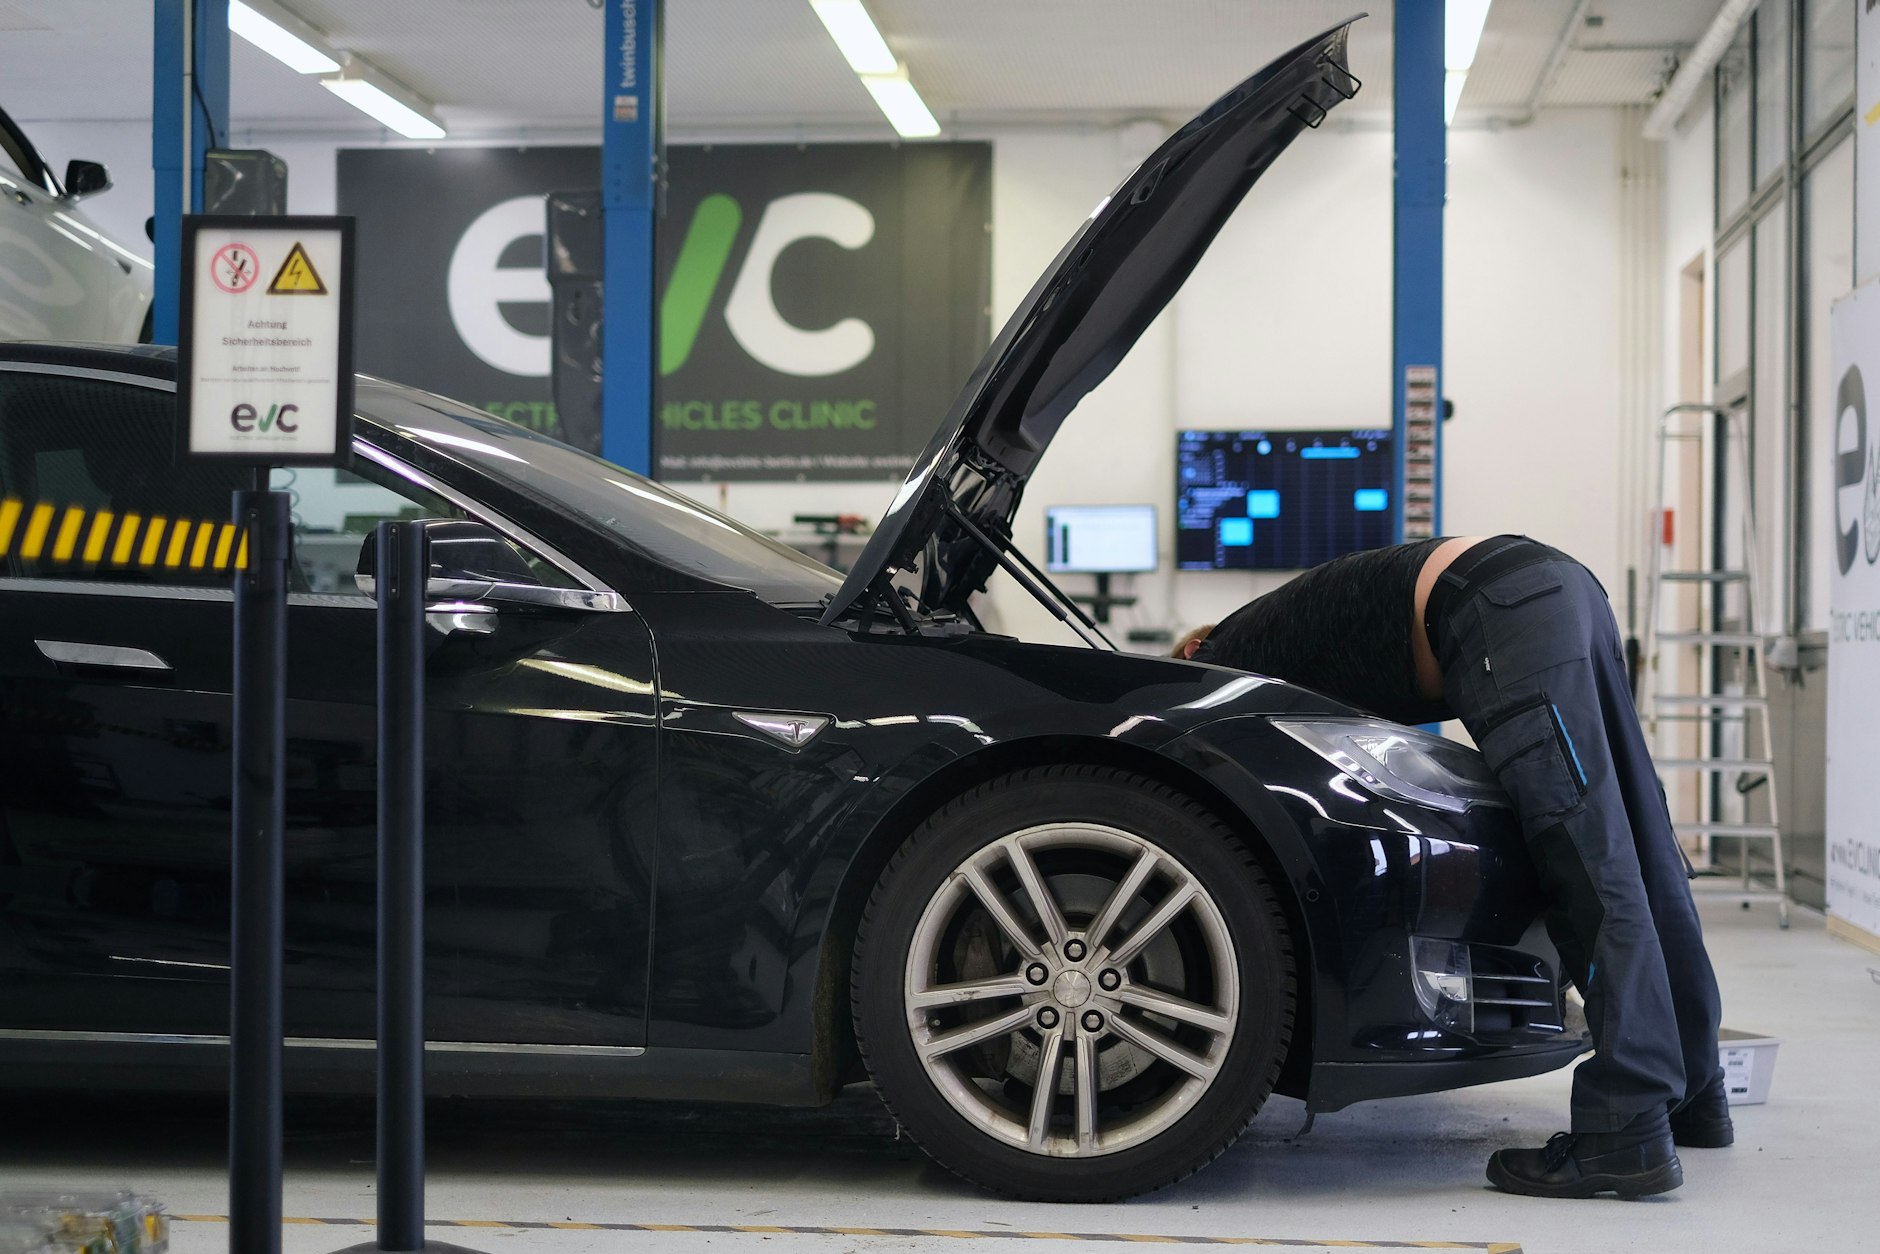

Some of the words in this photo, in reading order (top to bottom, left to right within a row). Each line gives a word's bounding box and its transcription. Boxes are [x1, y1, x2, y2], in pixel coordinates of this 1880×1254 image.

[247, 320, 288, 330] Achtung
[222, 336, 312, 347] Sicherheitsbereich
[231, 403, 299, 433] evc
[768, 400, 878, 431] CLINIC
